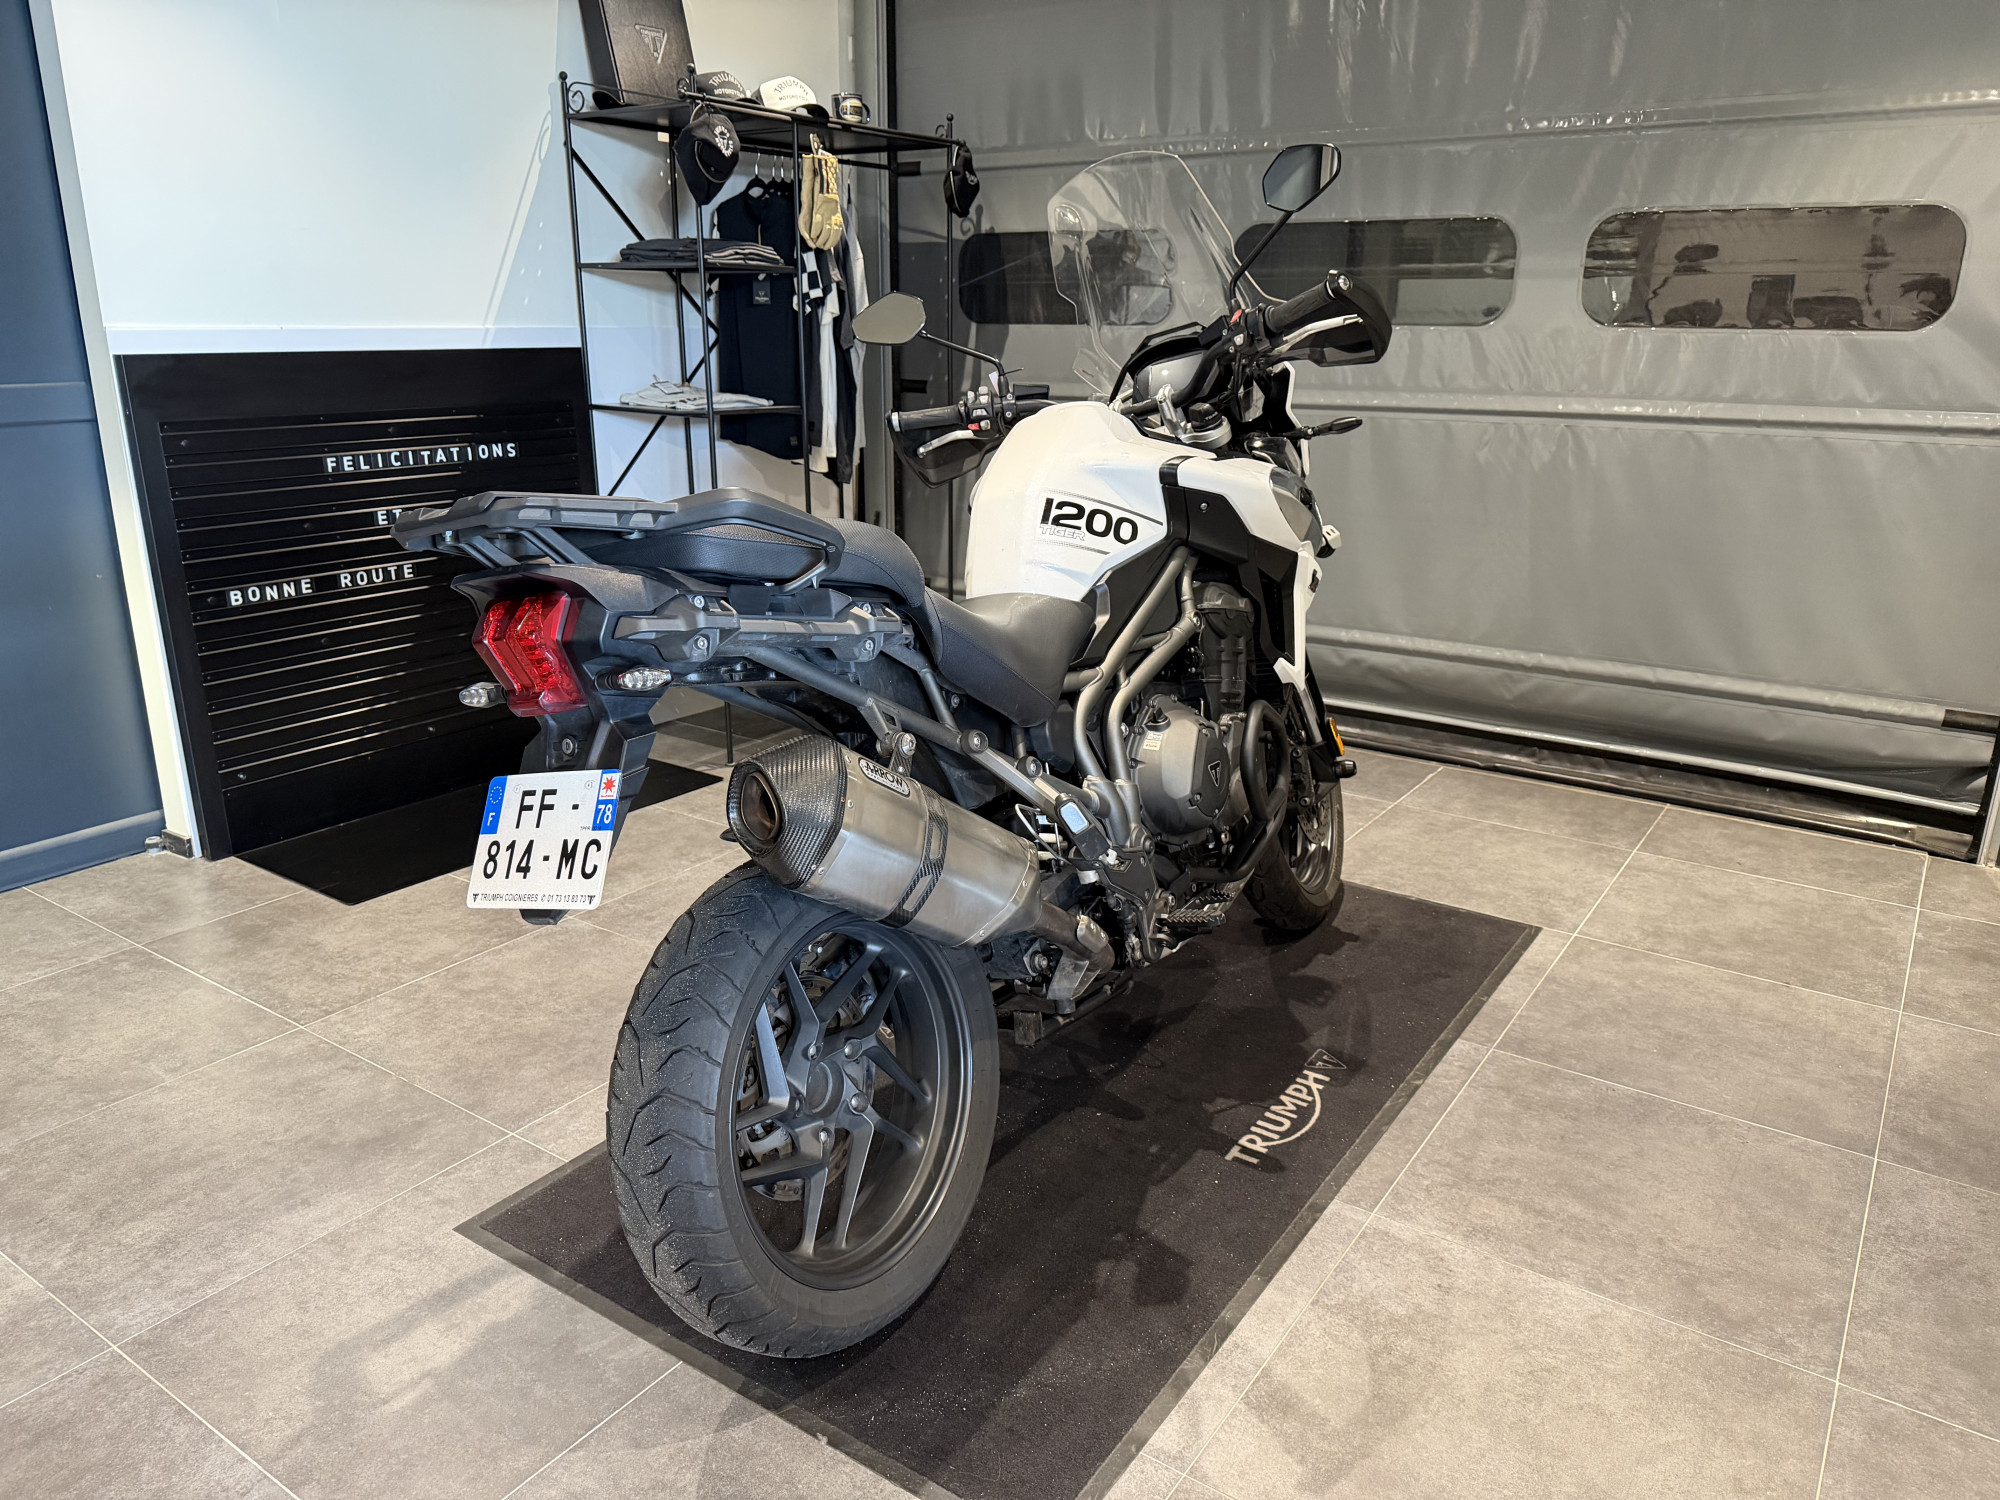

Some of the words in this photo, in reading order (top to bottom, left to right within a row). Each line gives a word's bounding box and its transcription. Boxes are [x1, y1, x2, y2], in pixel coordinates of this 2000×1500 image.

[325, 442, 518, 473] FELICITATIONS
[1040, 523, 1086, 542] TIGER
[1041, 497, 1139, 545] 1200
[229, 578, 313, 607] BONNE
[340, 563, 416, 589] ROUTE
[487, 812, 496, 826] F
[595, 804, 613, 825] 78
[1224, 1069, 1332, 1165] TRIUMPH
